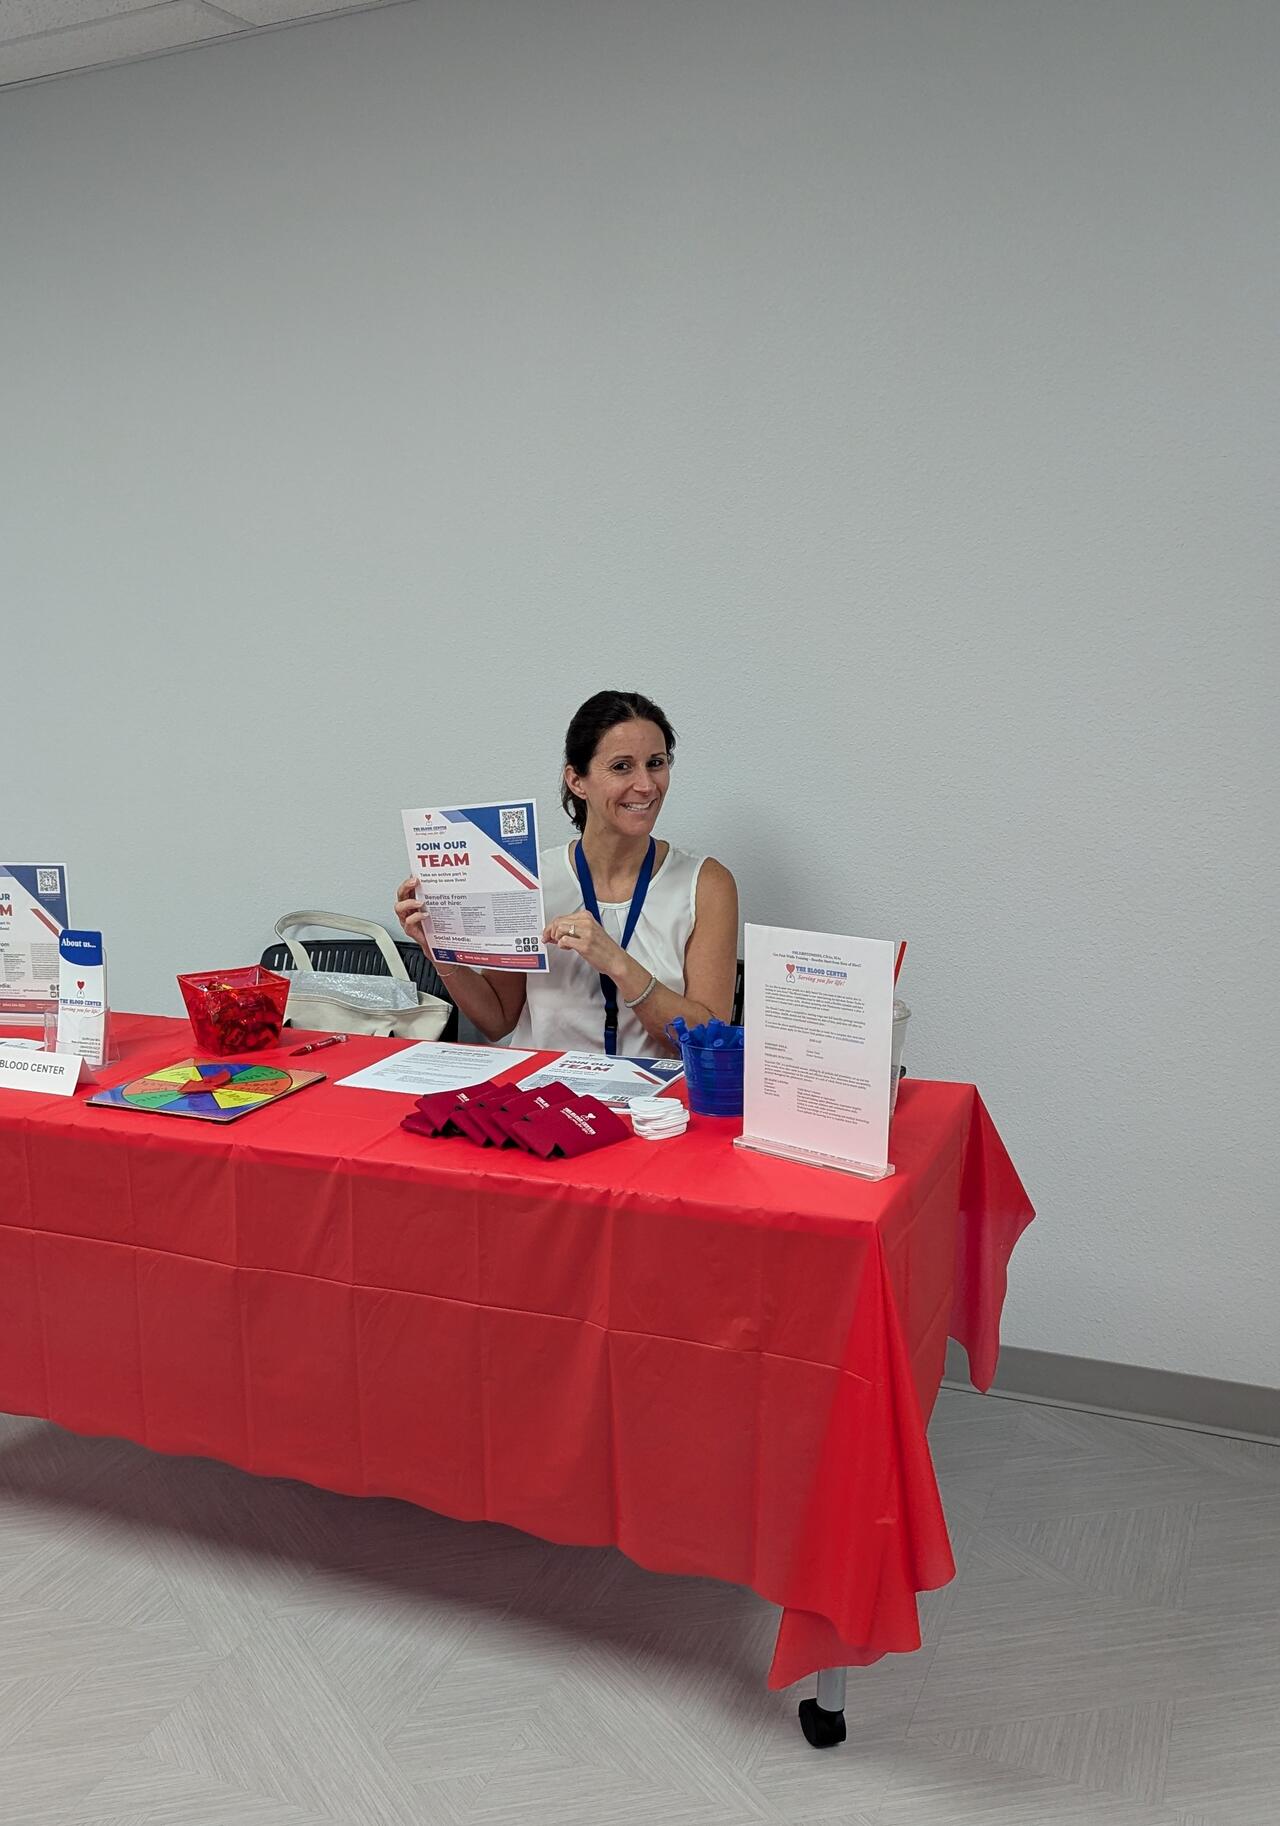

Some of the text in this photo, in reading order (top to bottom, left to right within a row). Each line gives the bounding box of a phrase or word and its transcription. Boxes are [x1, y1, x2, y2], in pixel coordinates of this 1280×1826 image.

[416, 841, 467, 851] JOIN OUR
[417, 853, 470, 867] TEAM
[61, 938, 81, 947] About
[826, 970, 848, 978] CENTER
[0, 1060, 65, 1075] BLOOD CENTER
[558, 1063, 610, 1072] TEAM
